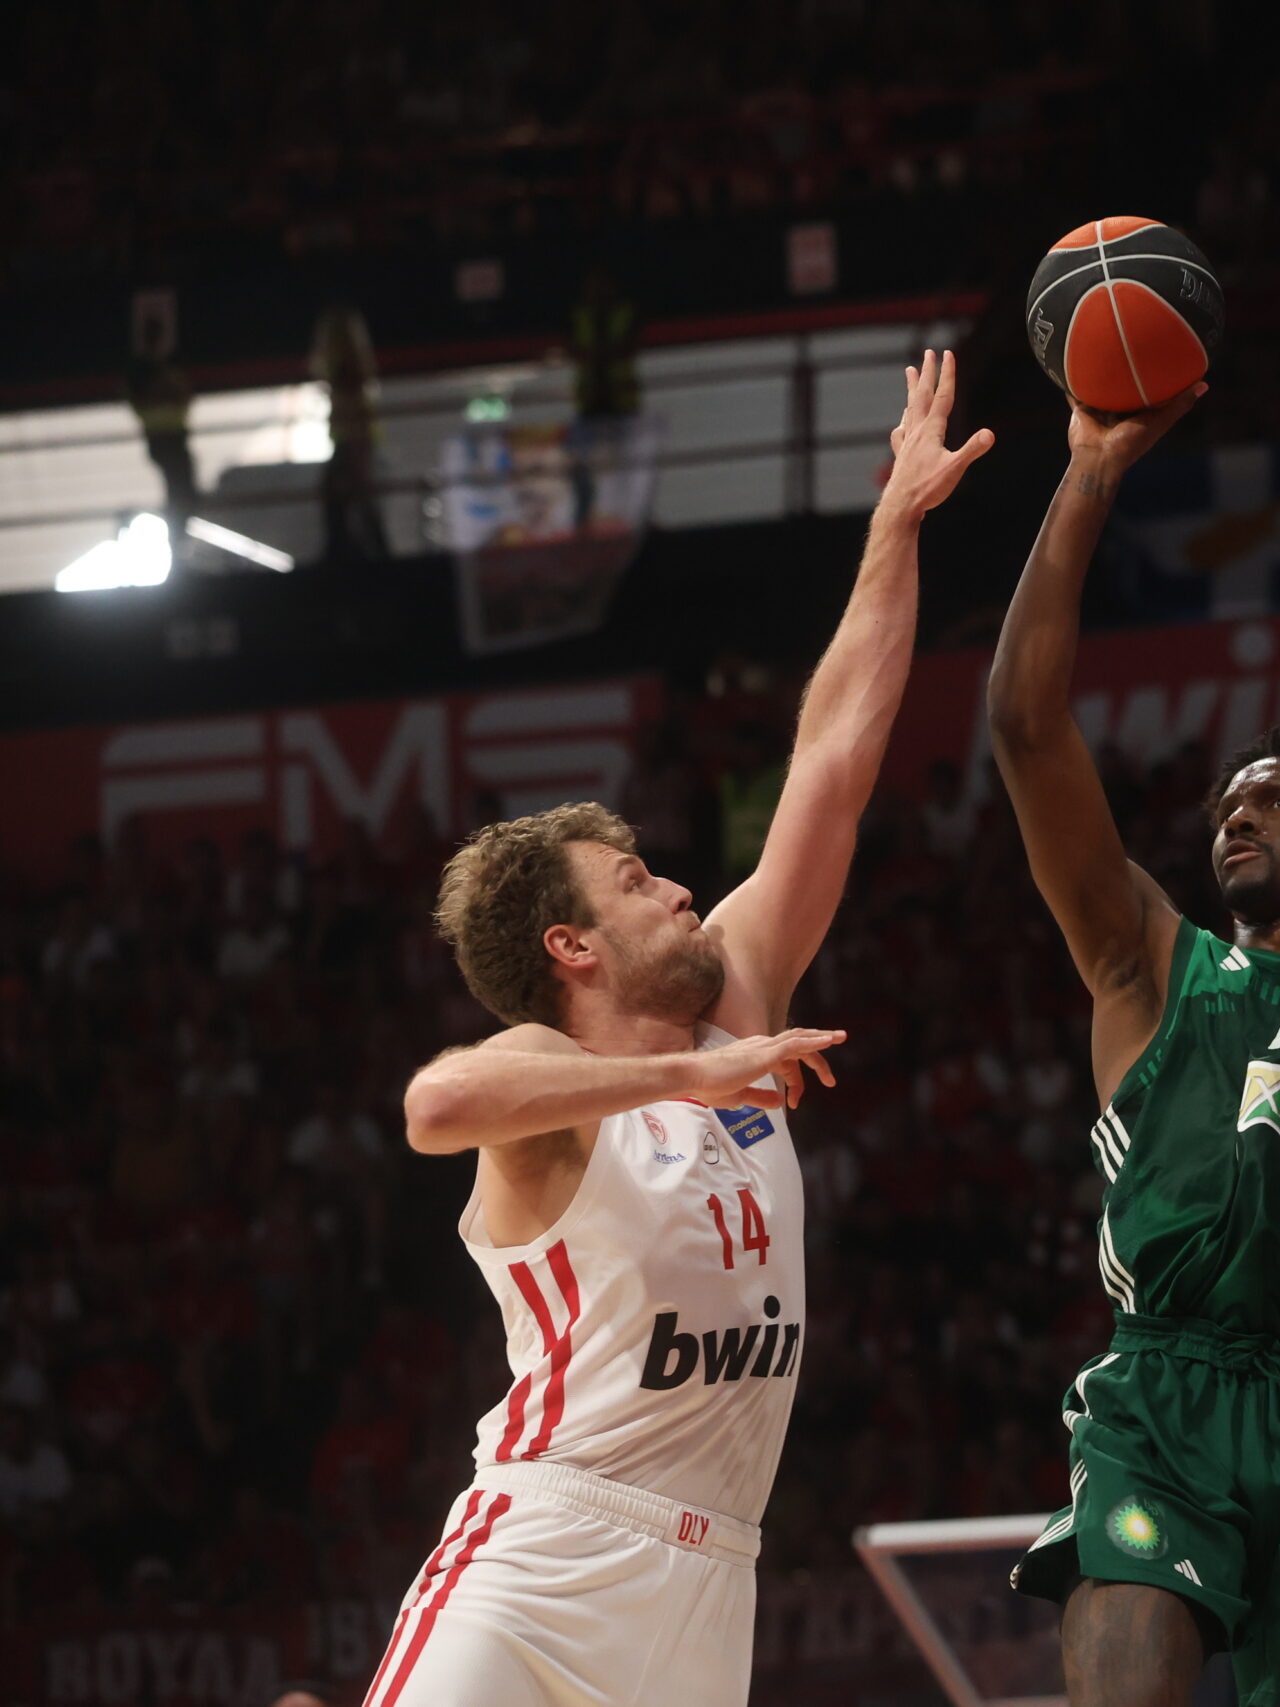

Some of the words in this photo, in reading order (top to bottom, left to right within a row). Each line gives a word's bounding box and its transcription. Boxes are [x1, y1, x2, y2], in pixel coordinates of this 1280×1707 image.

[99, 683, 638, 848] FMS
[744, 1125, 766, 1140] GBL
[706, 1188, 770, 1270] 14
[639, 1295, 800, 1391] bwin
[678, 1511, 710, 1546] OLY
